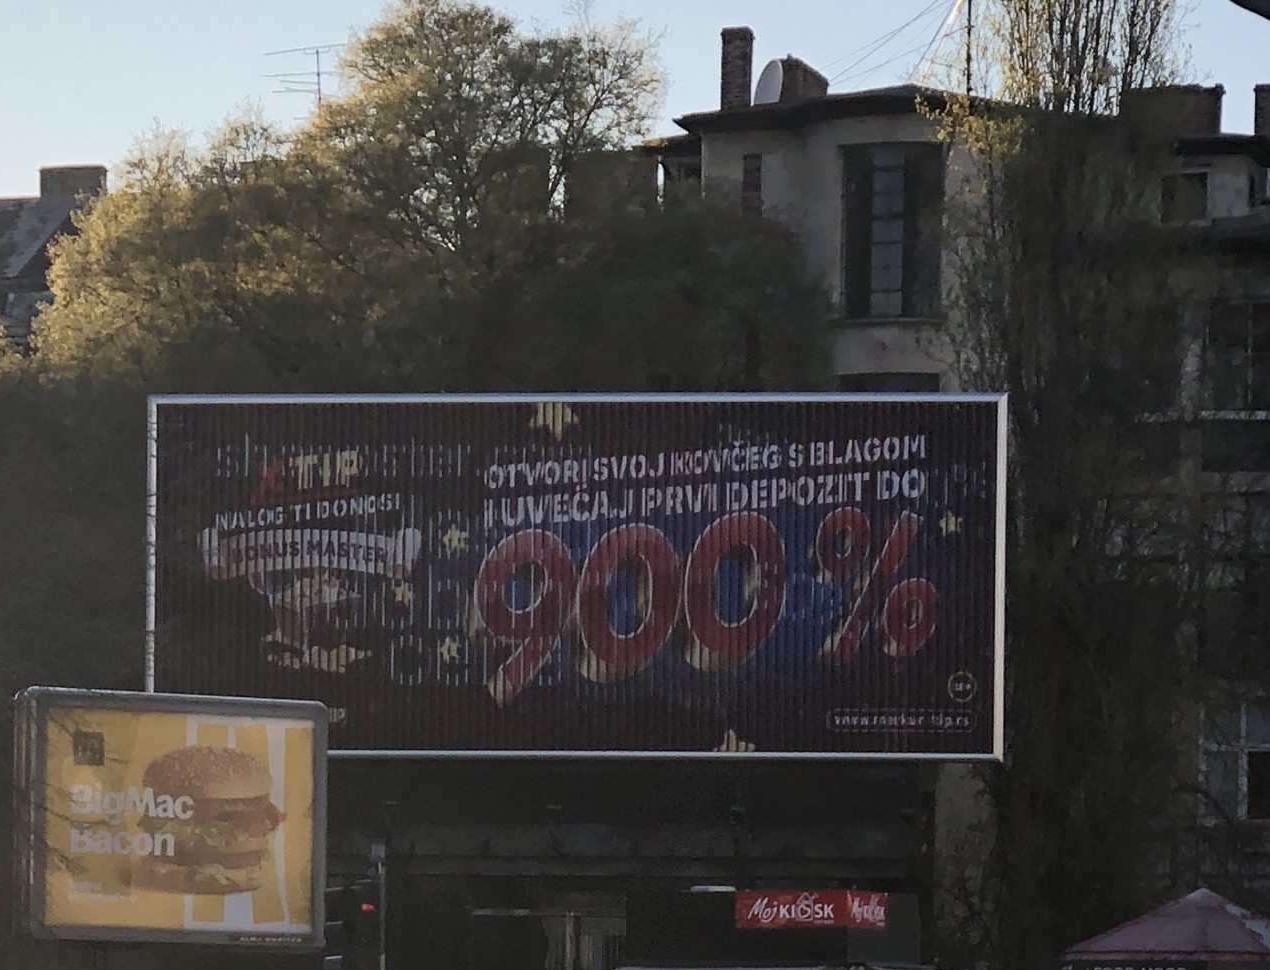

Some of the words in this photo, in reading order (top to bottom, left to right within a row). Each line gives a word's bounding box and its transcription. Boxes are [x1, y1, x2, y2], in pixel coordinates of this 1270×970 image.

[593, 452, 664, 481] SVOJ
[788, 442, 803, 467] S
[810, 435, 927, 465] BLAGOM
[642, 483, 717, 516] PRVI
[726, 472, 870, 511] DEPOZIT
[877, 468, 926, 500] DO
[70, 823, 175, 857] Bacon
